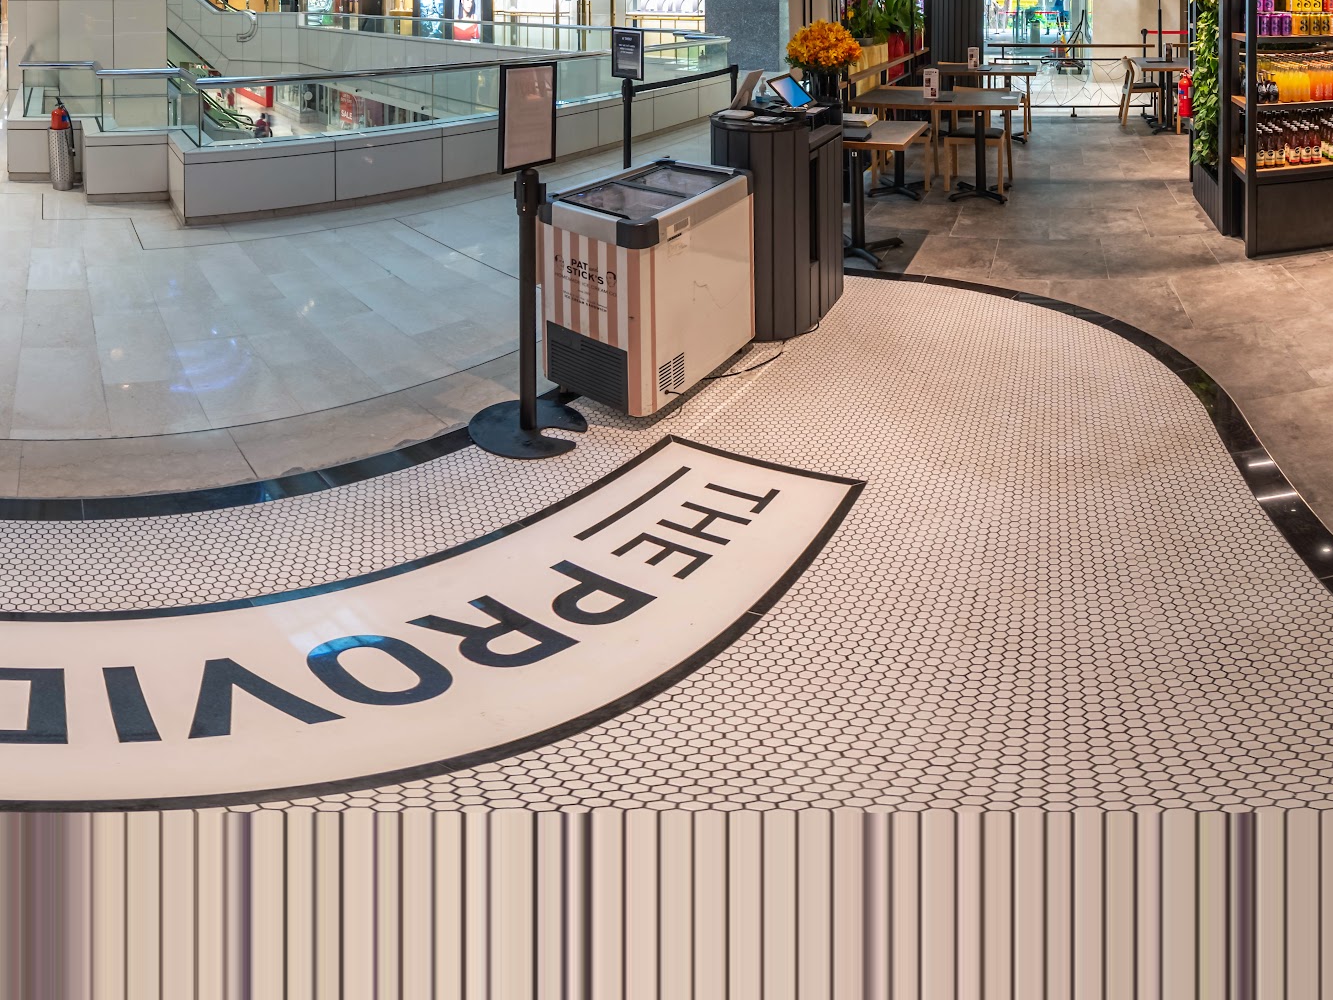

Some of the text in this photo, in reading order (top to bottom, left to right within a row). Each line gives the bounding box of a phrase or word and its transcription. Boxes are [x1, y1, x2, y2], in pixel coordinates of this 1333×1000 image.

[340, 110, 353, 120] SALE
[571, 258, 588, 271] PAT
[566, 265, 604, 285] STICK'S
[609, 482, 781, 580] THE
